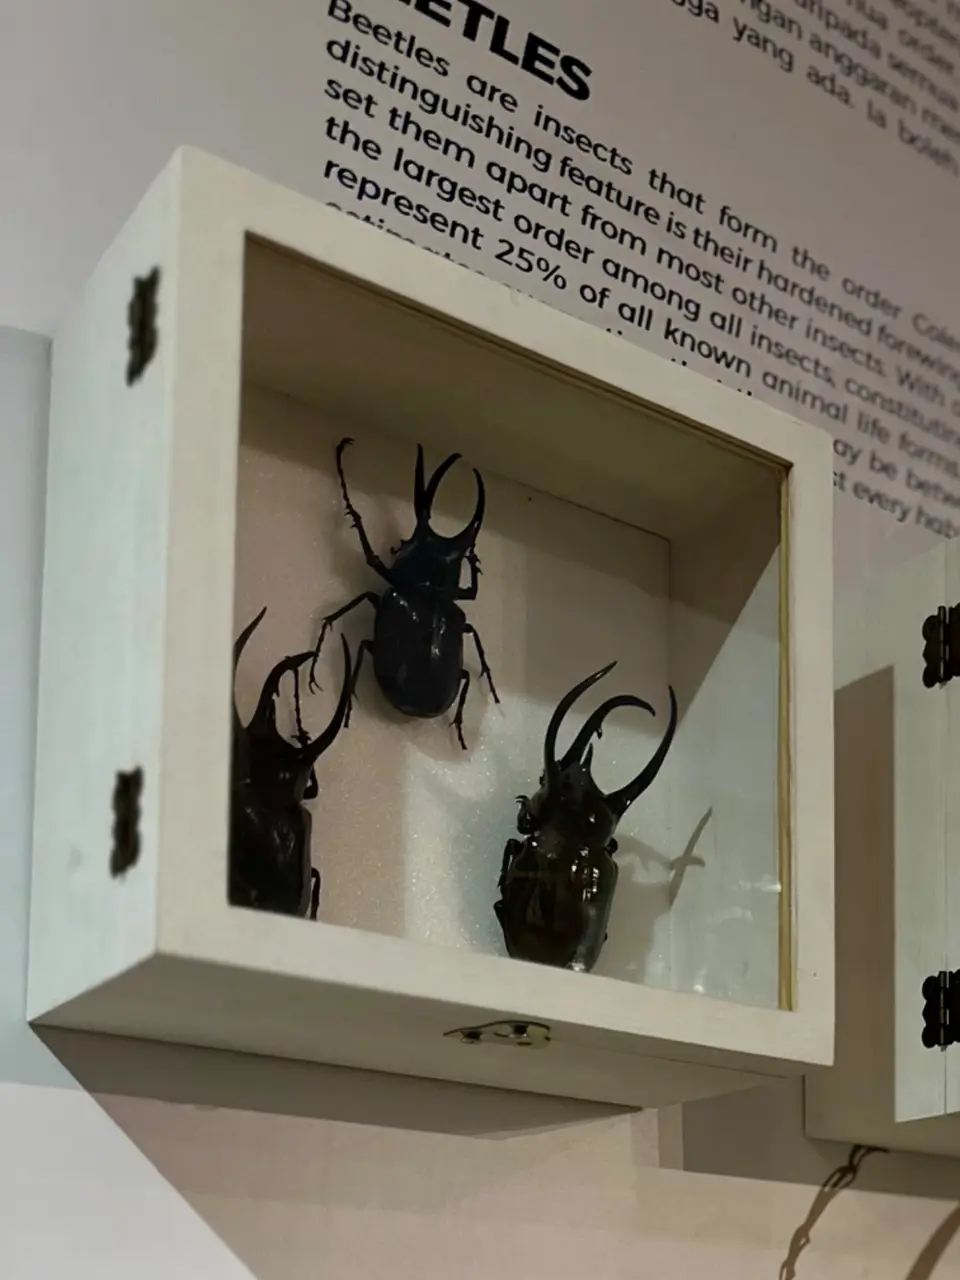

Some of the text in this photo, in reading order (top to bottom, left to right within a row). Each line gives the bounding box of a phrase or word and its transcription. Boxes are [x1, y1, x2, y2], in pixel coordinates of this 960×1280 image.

[328, 0, 450, 77] Beetles
[466, 74, 519, 113] are
[533, 104, 634, 176] insects
[648, 168, 706, 215] that
[719, 205, 778, 253] form
[791, 245, 831, 282] the
[841, 277, 903, 319] order
[398, 0, 593, 101] ETLES
[732, 16, 795, 73] yang
[323, 159, 485, 251] represent
[494, 238, 567, 291] 25%
[579, 283, 611, 309] of
[617, 301, 653, 332] all
[663, 318, 752, 379] known
[762, 370, 848, 425] animal
[857, 410, 891, 445] life
[324, 78, 378, 119] set
[388, 106, 476, 169] them
[486, 161, 573, 218] apart
[580, 204, 648, 256] from
[656, 247, 725, 295] most
[731, 286, 799, 331] other
[324, 116, 382, 161] the
[393, 147, 506, 223] largest
[513, 213, 595, 265] order
[602, 257, 701, 323] among
[709, 309, 743, 340] all
[750, 325, 836, 388] insects,
[326, 39, 552, 173] distinguishing
[559, 155, 661, 225] feature
[665, 211, 688, 240] is
[693, 226, 754, 273] their
[757, 259, 873, 338] hardened
[832, 437, 862, 466] ay
[868, 450, 898, 481] be
[852, 480, 912, 524] every
